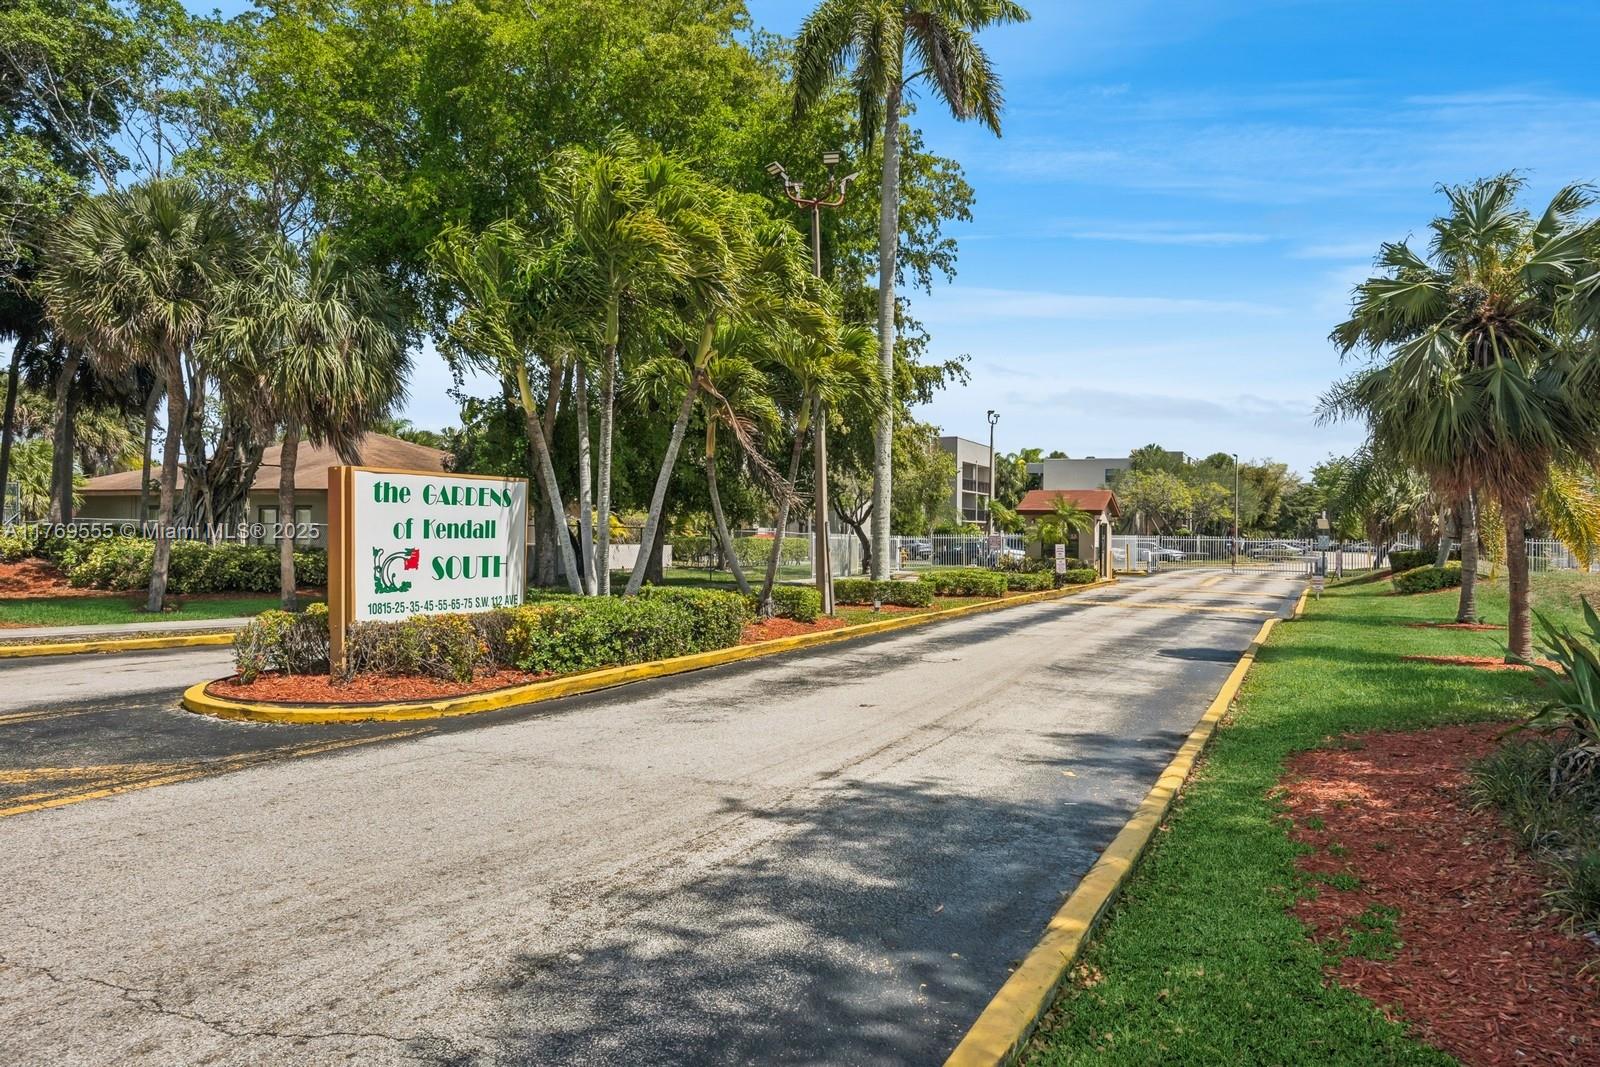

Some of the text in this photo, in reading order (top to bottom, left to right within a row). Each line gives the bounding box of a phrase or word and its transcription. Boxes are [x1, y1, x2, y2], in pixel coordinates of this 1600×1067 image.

[373, 481, 512, 507] the GARDENS
[393, 518, 496, 539] of Kendall
[432, 555, 508, 580] SOUTH
[475, 596, 490, 608] S.W.
[491, 595, 503, 606] 112
[504, 594, 518, 606] AVE
